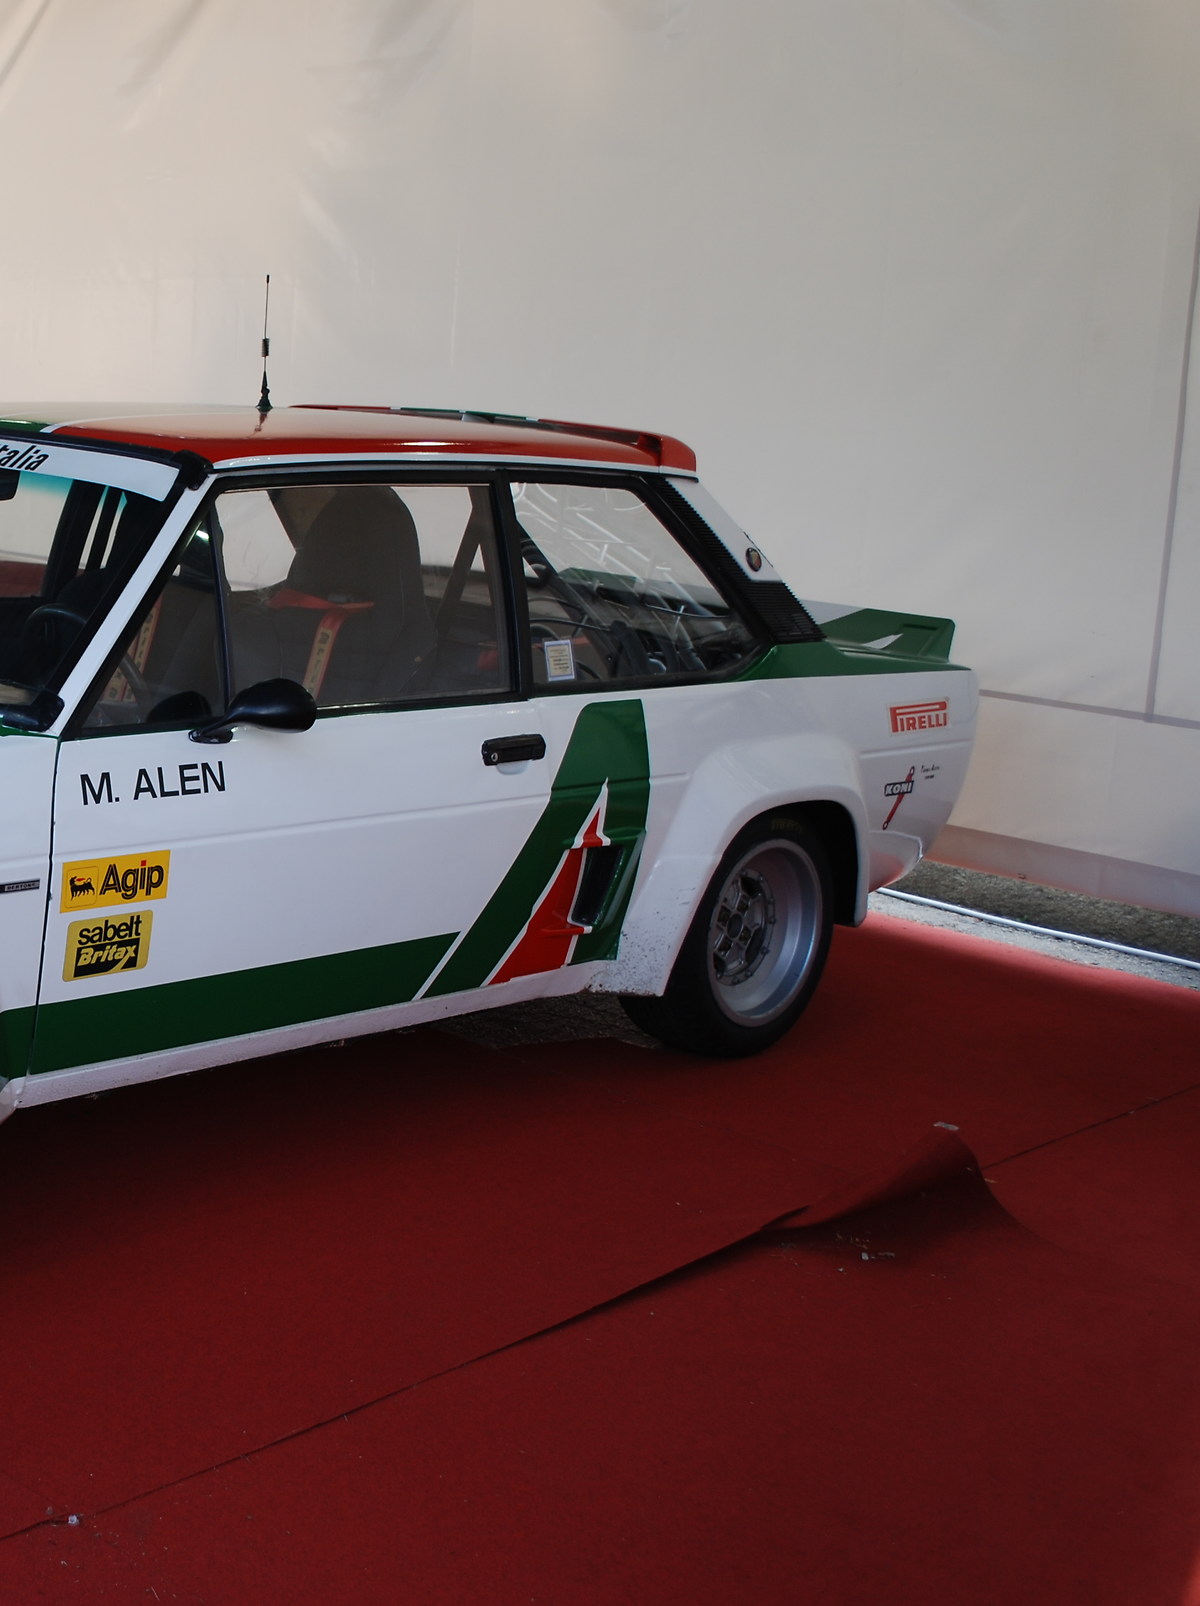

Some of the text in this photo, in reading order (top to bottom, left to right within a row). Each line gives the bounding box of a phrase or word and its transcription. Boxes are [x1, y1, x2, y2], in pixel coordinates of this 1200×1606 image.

[889, 701, 947, 733] PIRELLI
[80, 760, 227, 806] M. ALEN
[885, 781, 912, 796] KONI
[99, 859, 165, 900] Agip
[77, 914, 143, 946] sabelt
[77, 943, 138, 968] Britax
